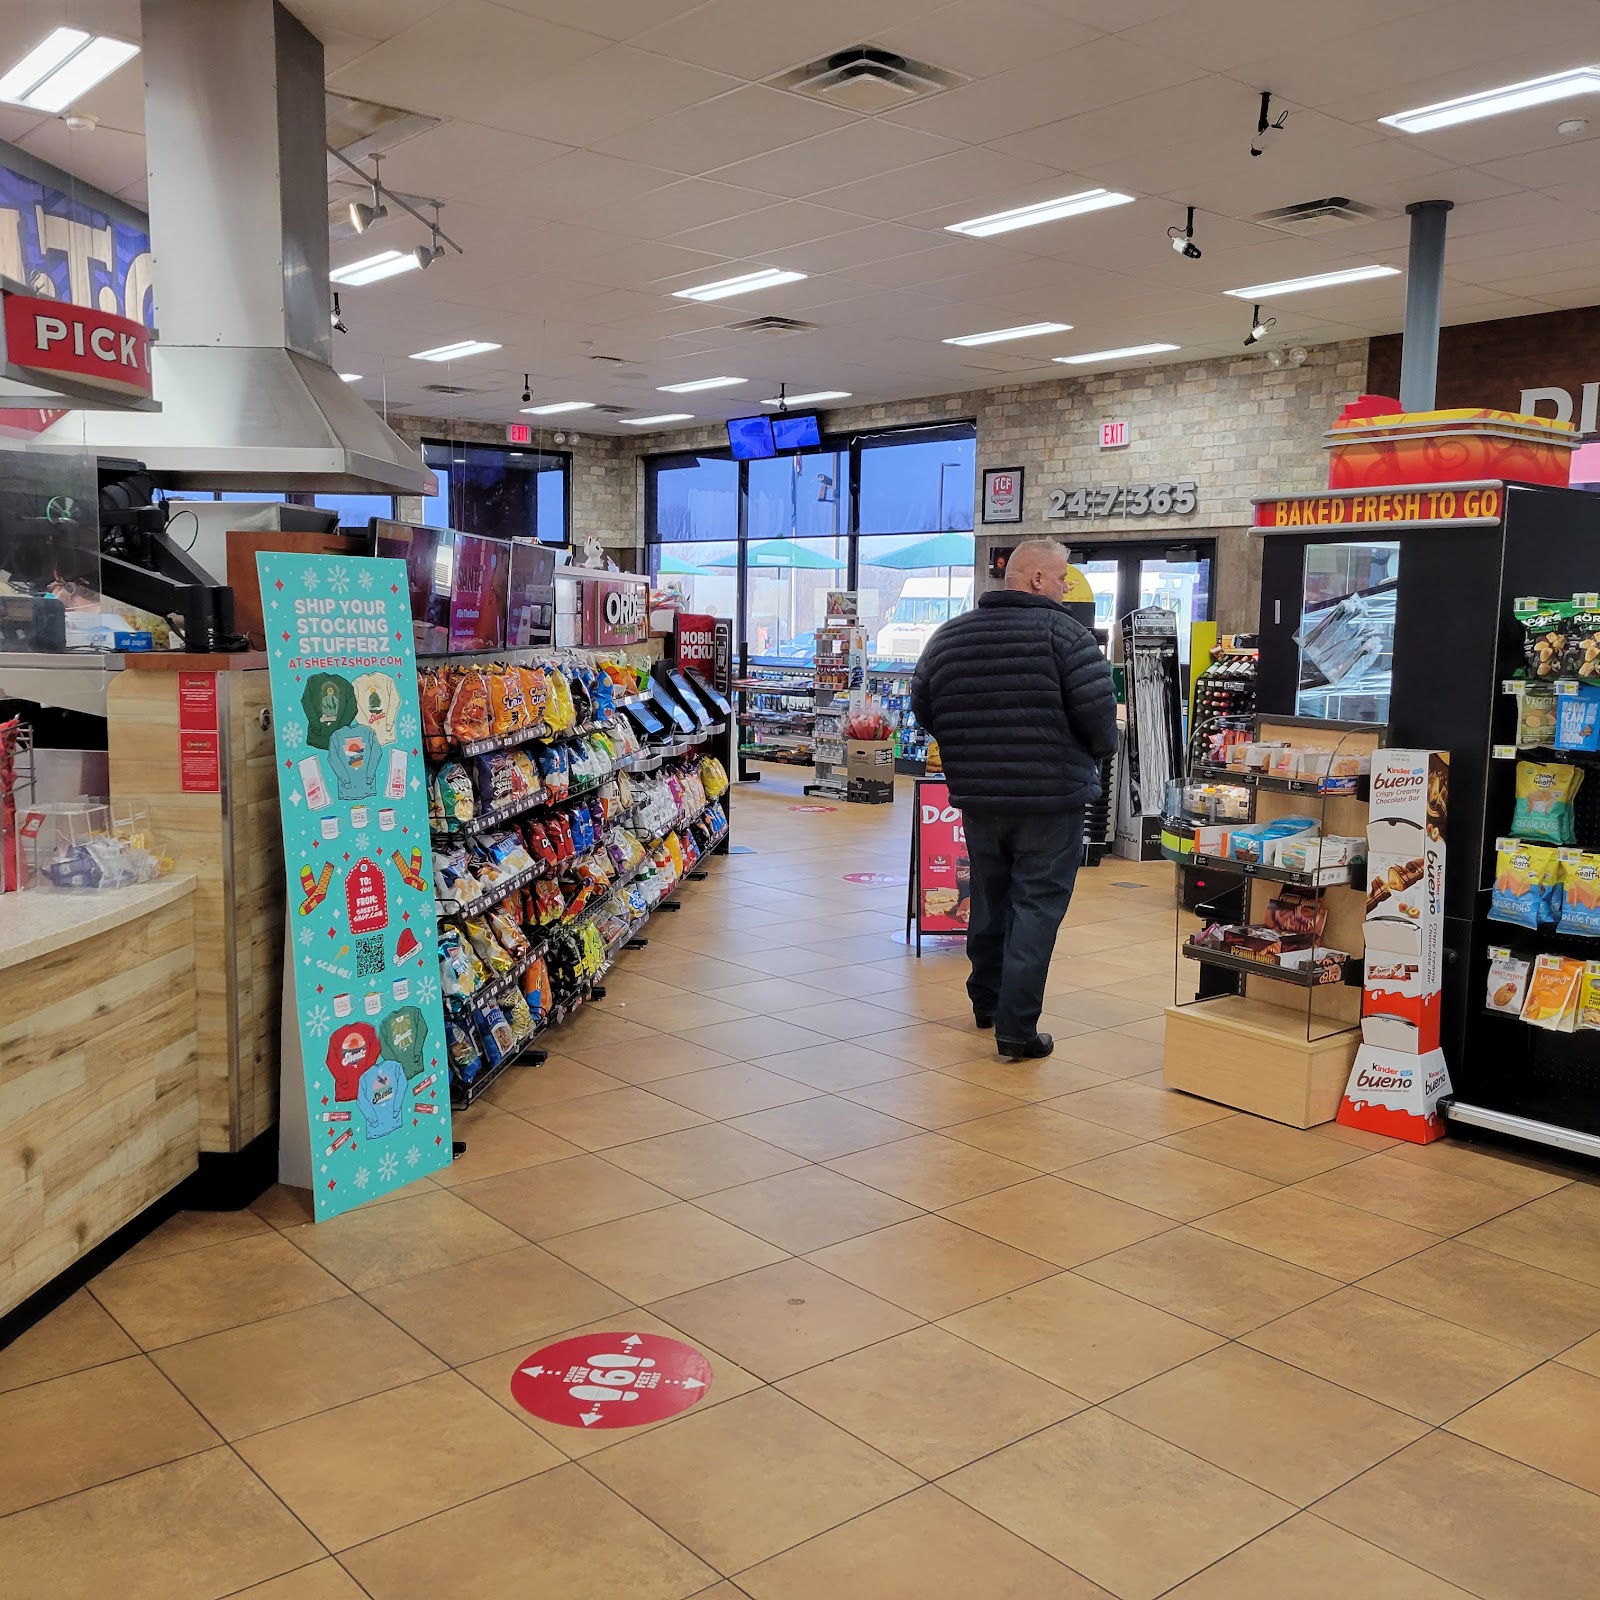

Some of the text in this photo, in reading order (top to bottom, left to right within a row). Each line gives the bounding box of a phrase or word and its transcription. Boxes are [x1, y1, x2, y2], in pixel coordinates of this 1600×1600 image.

[35, 315, 139, 369] PICK
[1103, 423, 1124, 444] EXIT
[995, 476, 1011, 490] TCF
[1275, 490, 1497, 527] BAKED FRESH TO GO
[294, 598, 386, 615] SHIP YOUR
[296, 617, 388, 635] STOCKING
[298, 636, 390, 654] STUFFERZ
[289, 657, 302, 669] AT
[1373, 772, 1424, 790] bueno
[1375, 788, 1420, 798] Crispy Creamy
[1375, 797, 1407, 805] Chocolate
[359, 876, 371, 886] TO:
[1426, 850, 1438, 915] bueno
[359, 886, 373, 895] YOU
[356, 895, 378, 907] FROM:
[316, 960, 337, 974] SCAN
[1356, 1069, 1412, 1089] bueno
[1425, 1073, 1446, 1096] bueno
[571, 1366, 590, 1384] STAY
[588, 1368, 636, 1386] 6
[633, 1371, 652, 1389] FEET
